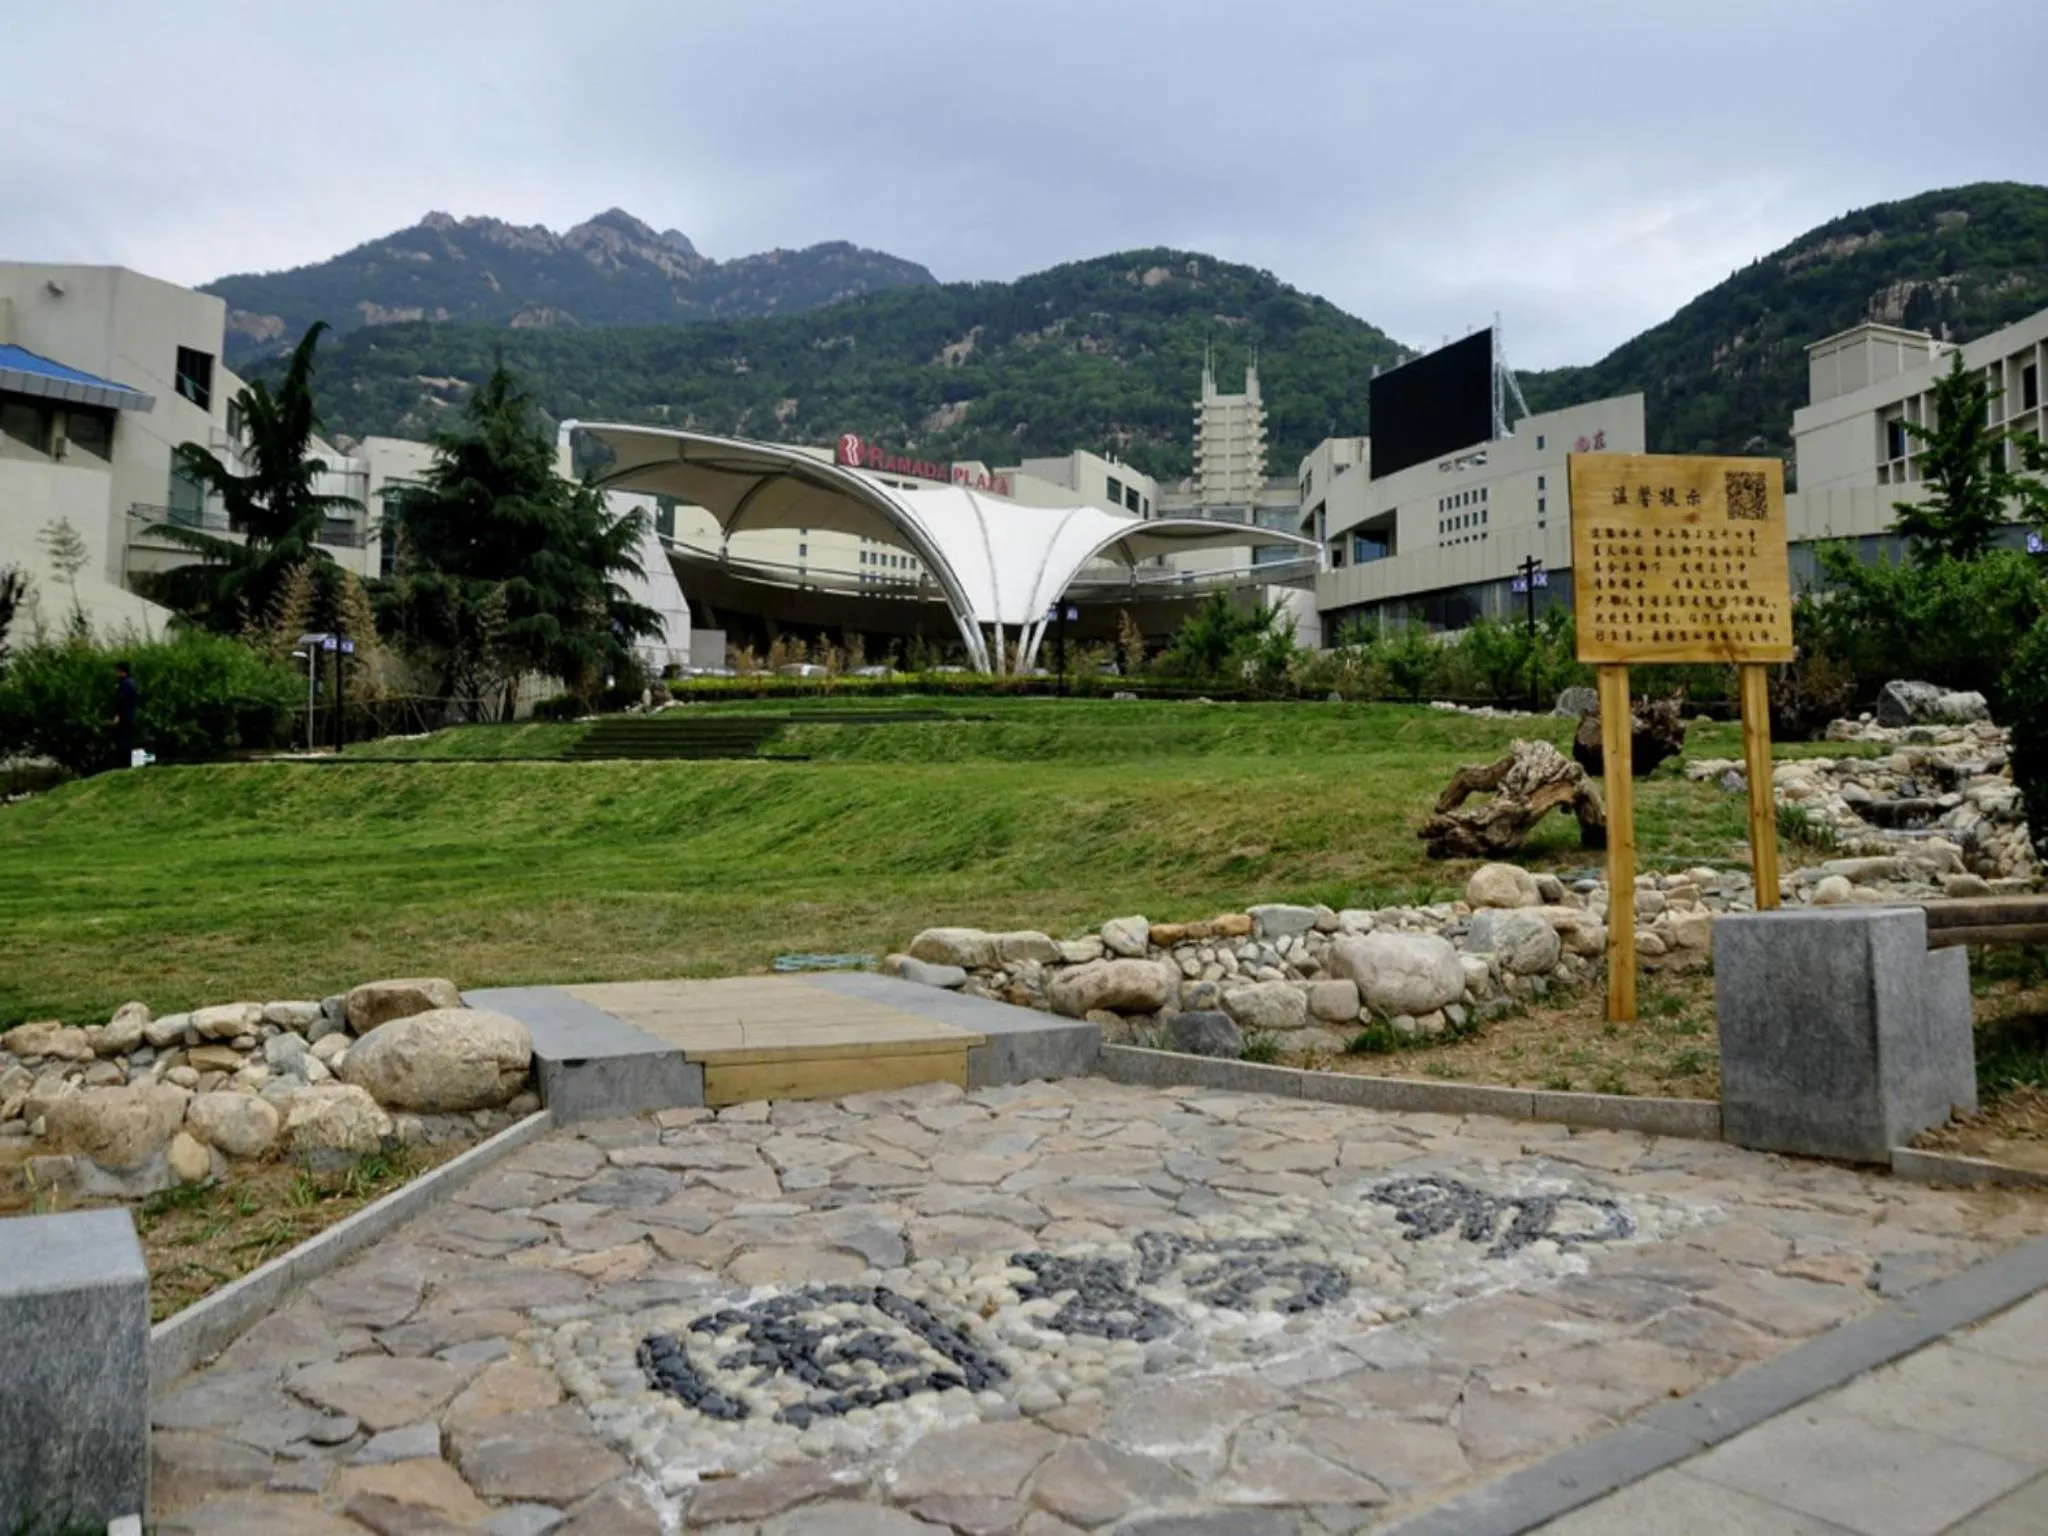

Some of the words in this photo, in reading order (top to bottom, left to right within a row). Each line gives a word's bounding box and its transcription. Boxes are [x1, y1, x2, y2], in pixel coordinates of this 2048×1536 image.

[868, 446, 948, 480] RAMADA
[1611, 485, 1701, 509] 温馨提示
